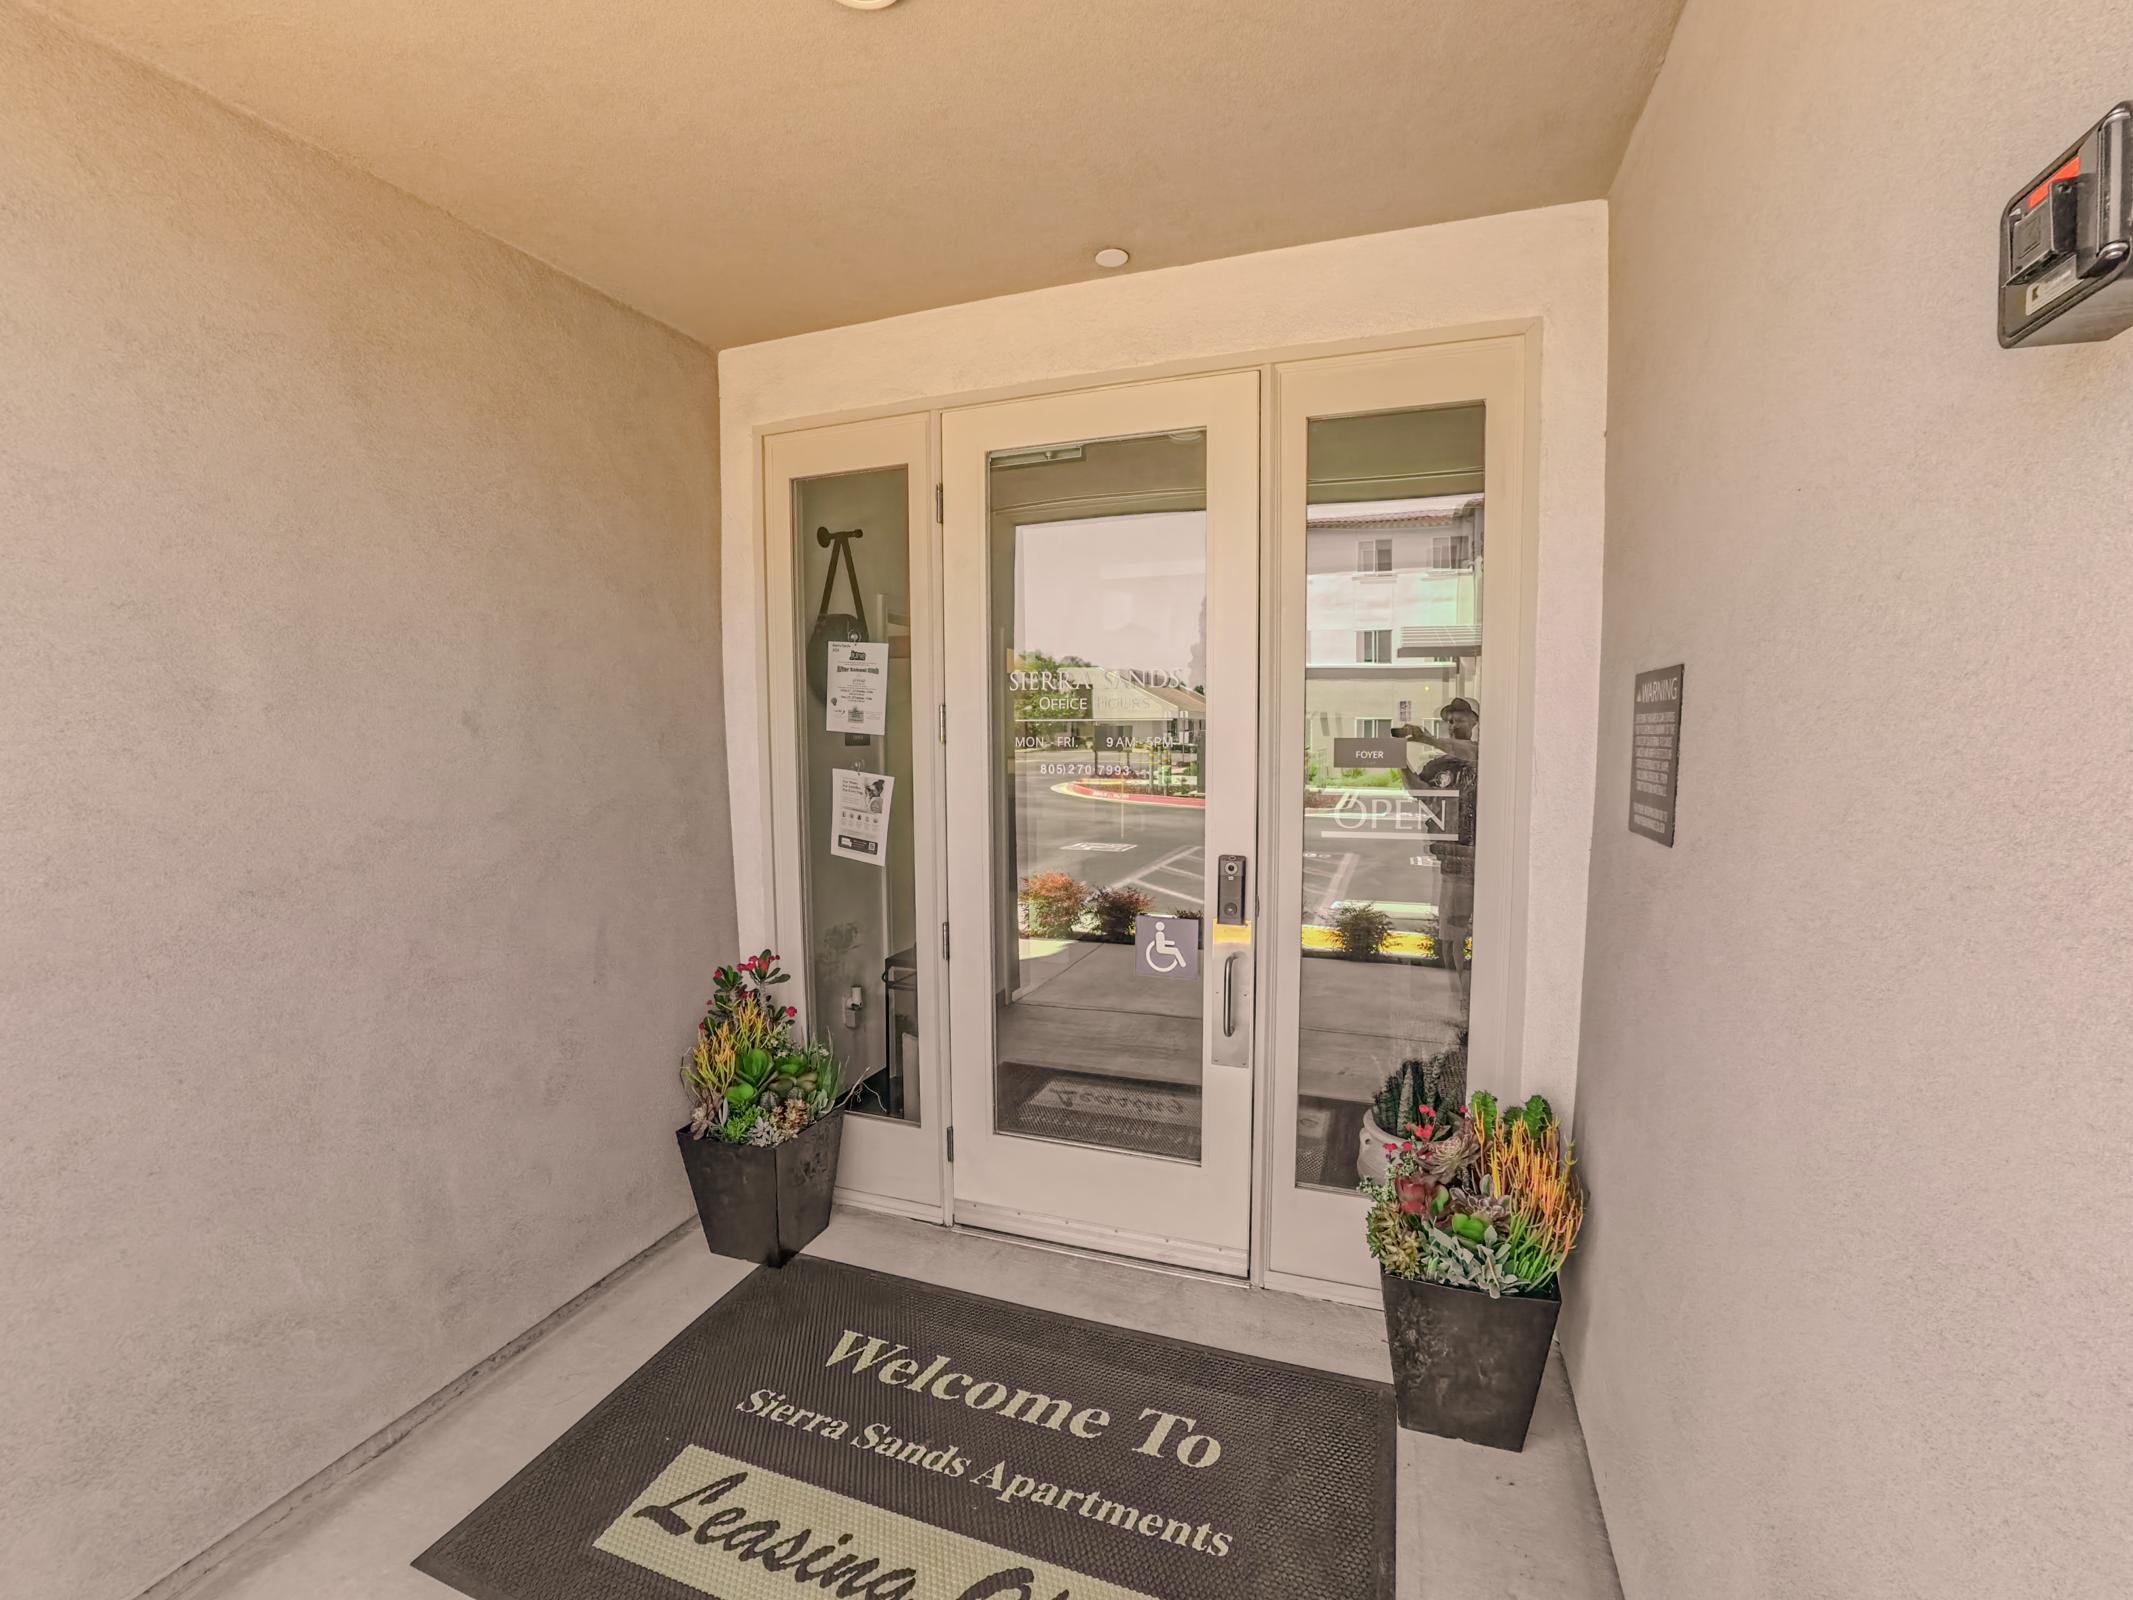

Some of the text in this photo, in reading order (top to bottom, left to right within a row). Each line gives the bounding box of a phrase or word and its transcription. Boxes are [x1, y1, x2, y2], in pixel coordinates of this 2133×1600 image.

[1009, 671, 1092, 691] SIERRA
[1642, 678, 1678, 703] WARNING
[1057, 736, 1079, 748] FRI.
[1355, 750, 1384, 759] FOYER
[1334, 798, 1446, 831] OPEN
[825, 1329, 1222, 1469] Welcome To
[736, 1387, 1232, 1561] Sierra Sands Apartments
